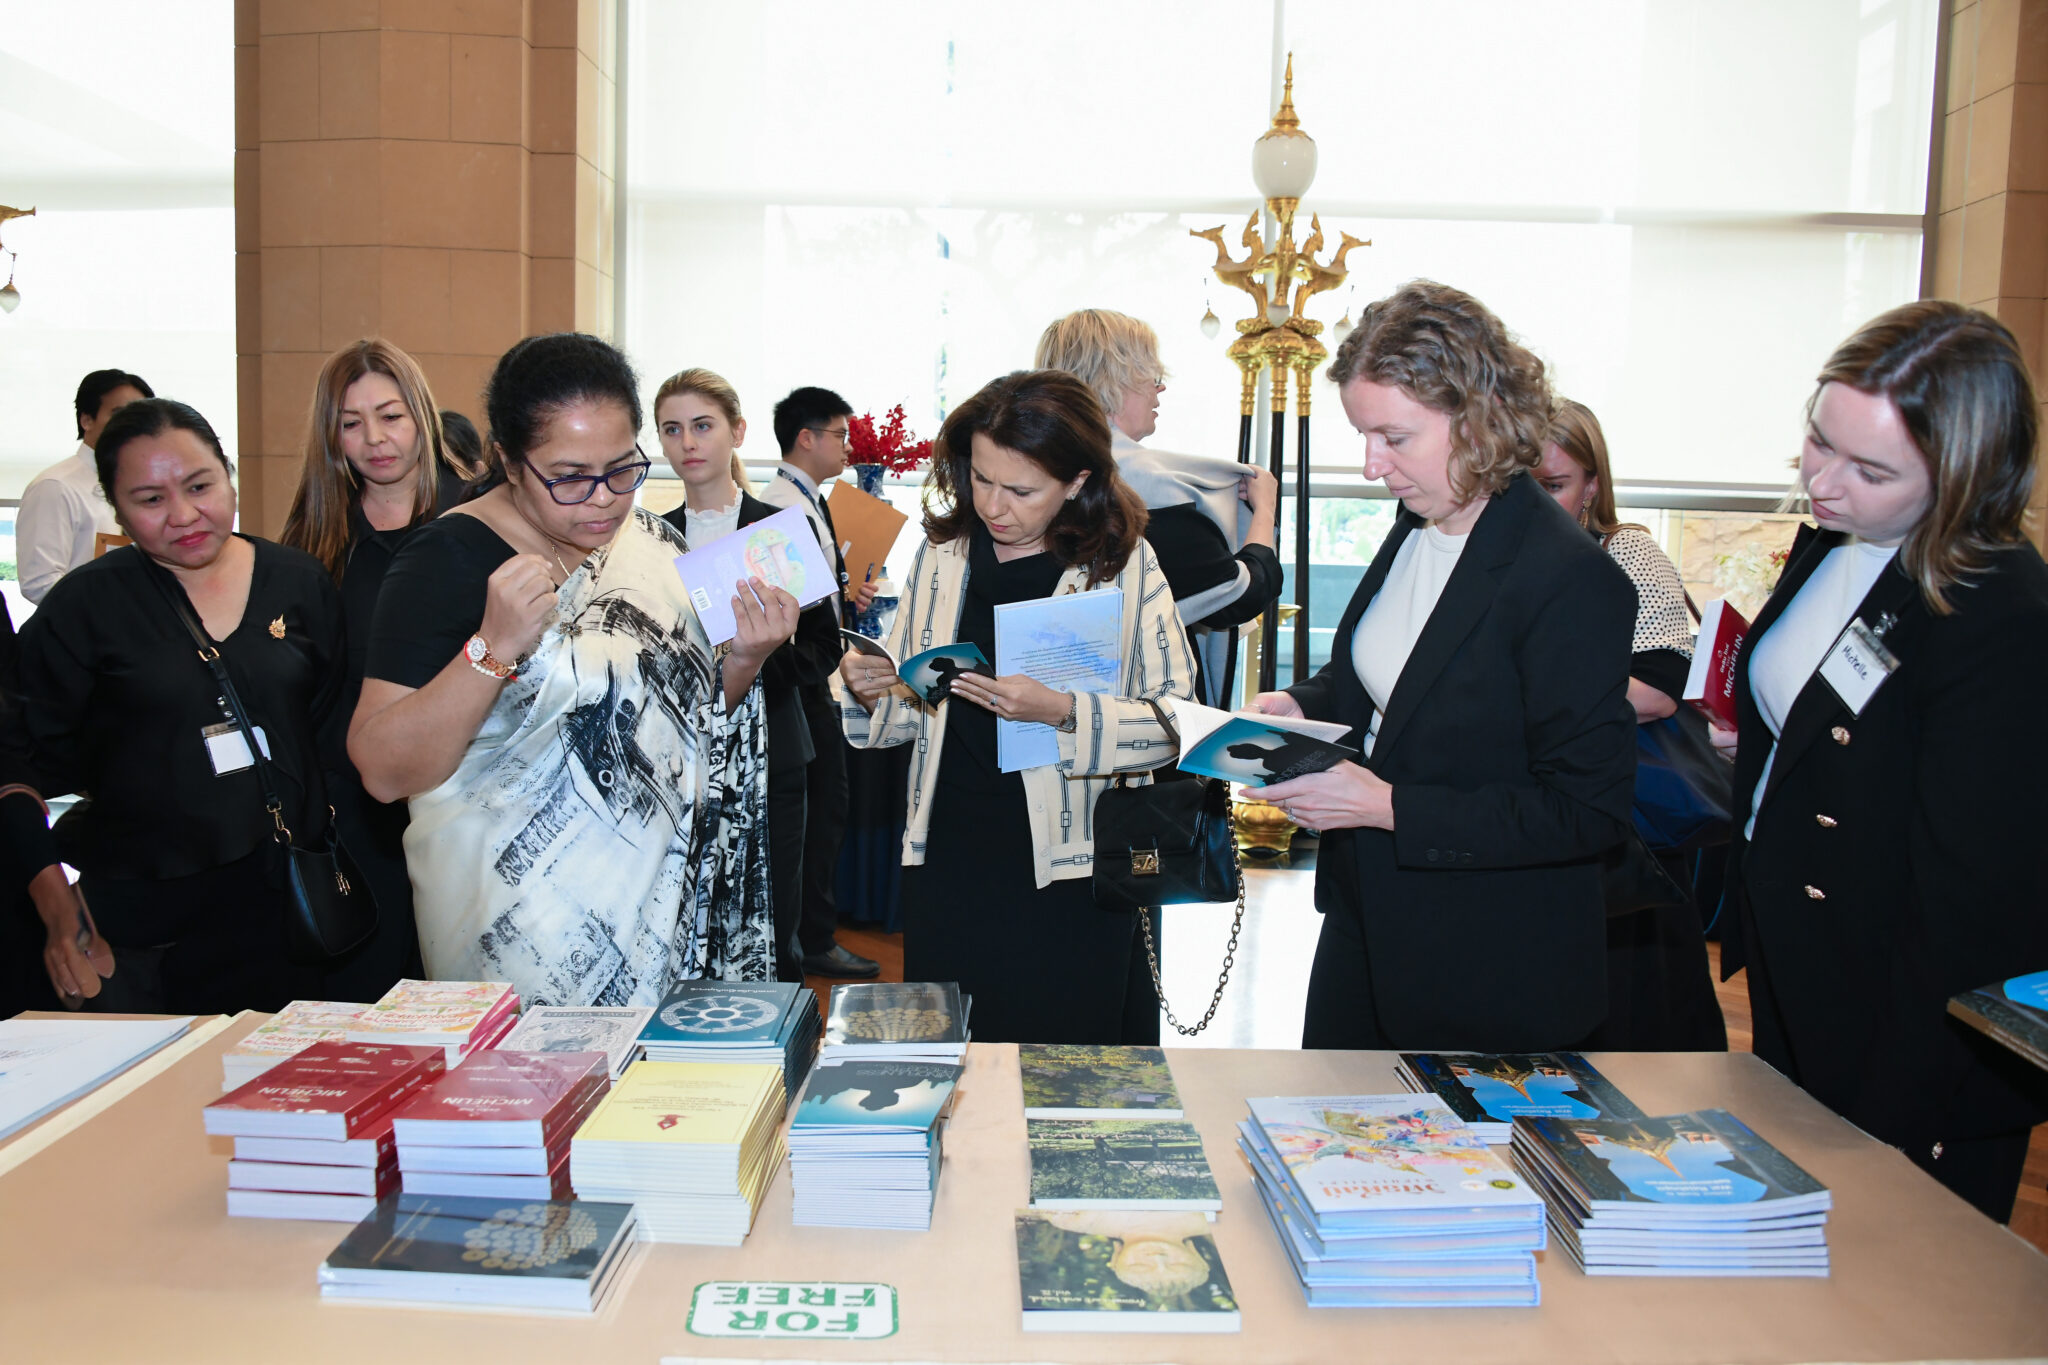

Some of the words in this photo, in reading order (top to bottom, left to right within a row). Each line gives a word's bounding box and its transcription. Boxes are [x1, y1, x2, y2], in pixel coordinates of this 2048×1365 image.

[258, 1086, 348, 1098] MICHELIN
[442, 1096, 533, 1106] MICHELIN
[713, 1286, 877, 1307] FREE
[727, 1310, 859, 1333] FOR
